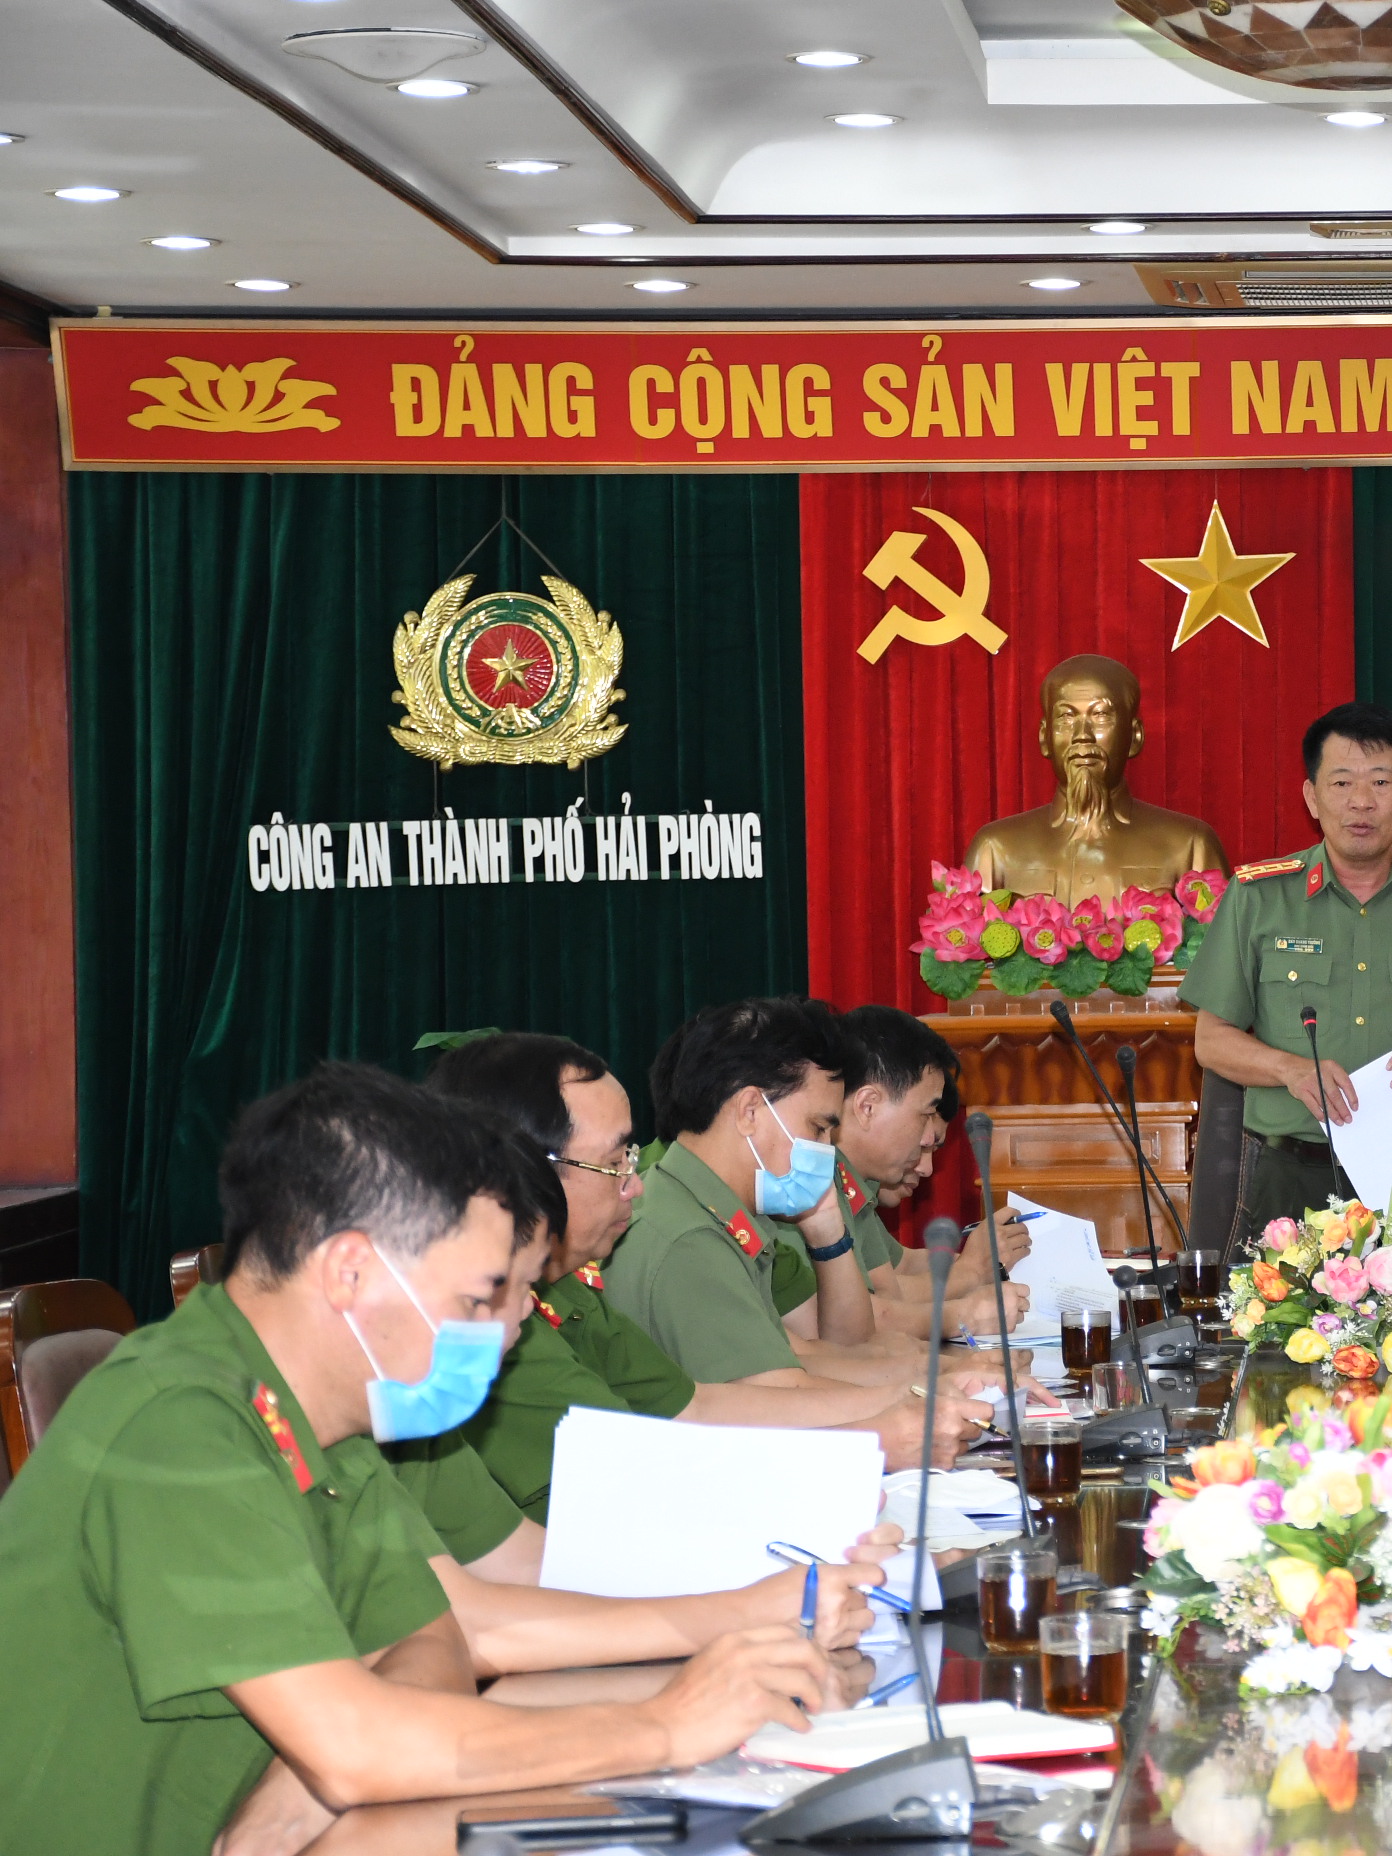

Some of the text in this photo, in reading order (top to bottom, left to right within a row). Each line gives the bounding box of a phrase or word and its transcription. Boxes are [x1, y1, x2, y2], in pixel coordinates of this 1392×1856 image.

[390, 335, 597, 438] ĐẢNG
[629, 347, 834, 454] CỘNG
[861, 334, 1016, 438] SẢN
[1046, 347, 1200, 450] VIỆT
[248, 791, 763, 892] CÔNG AN THÀNH PHỐ HẢI PHÒNG
